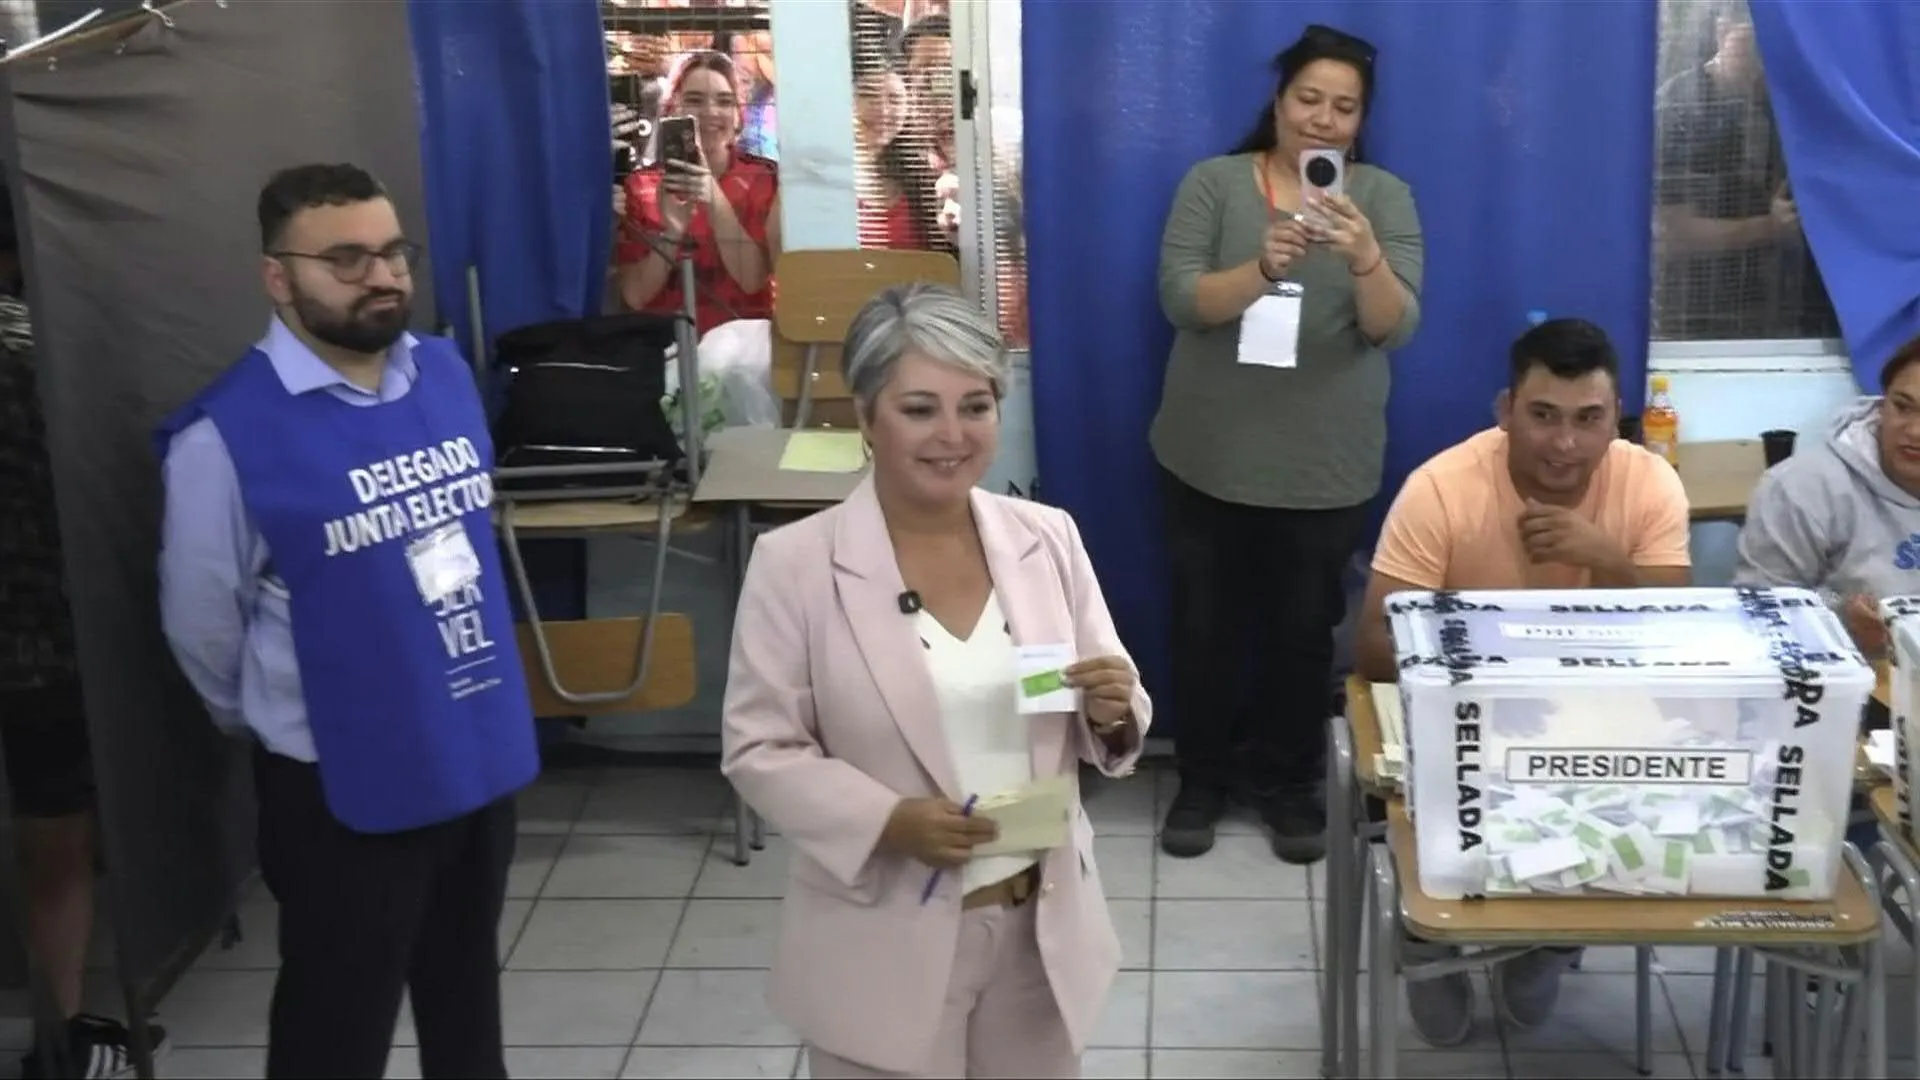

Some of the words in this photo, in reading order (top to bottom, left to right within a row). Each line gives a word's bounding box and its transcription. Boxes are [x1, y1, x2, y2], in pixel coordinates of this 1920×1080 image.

[348, 436, 480, 504] DELEGADO
[324, 501, 412, 556] JUNTA
[437, 609, 495, 659] VEL
[1455, 701, 1483, 852] SELLADA
[1528, 755, 1727, 779] PRESIDENTE
[1764, 745, 1804, 892] SELLADA
